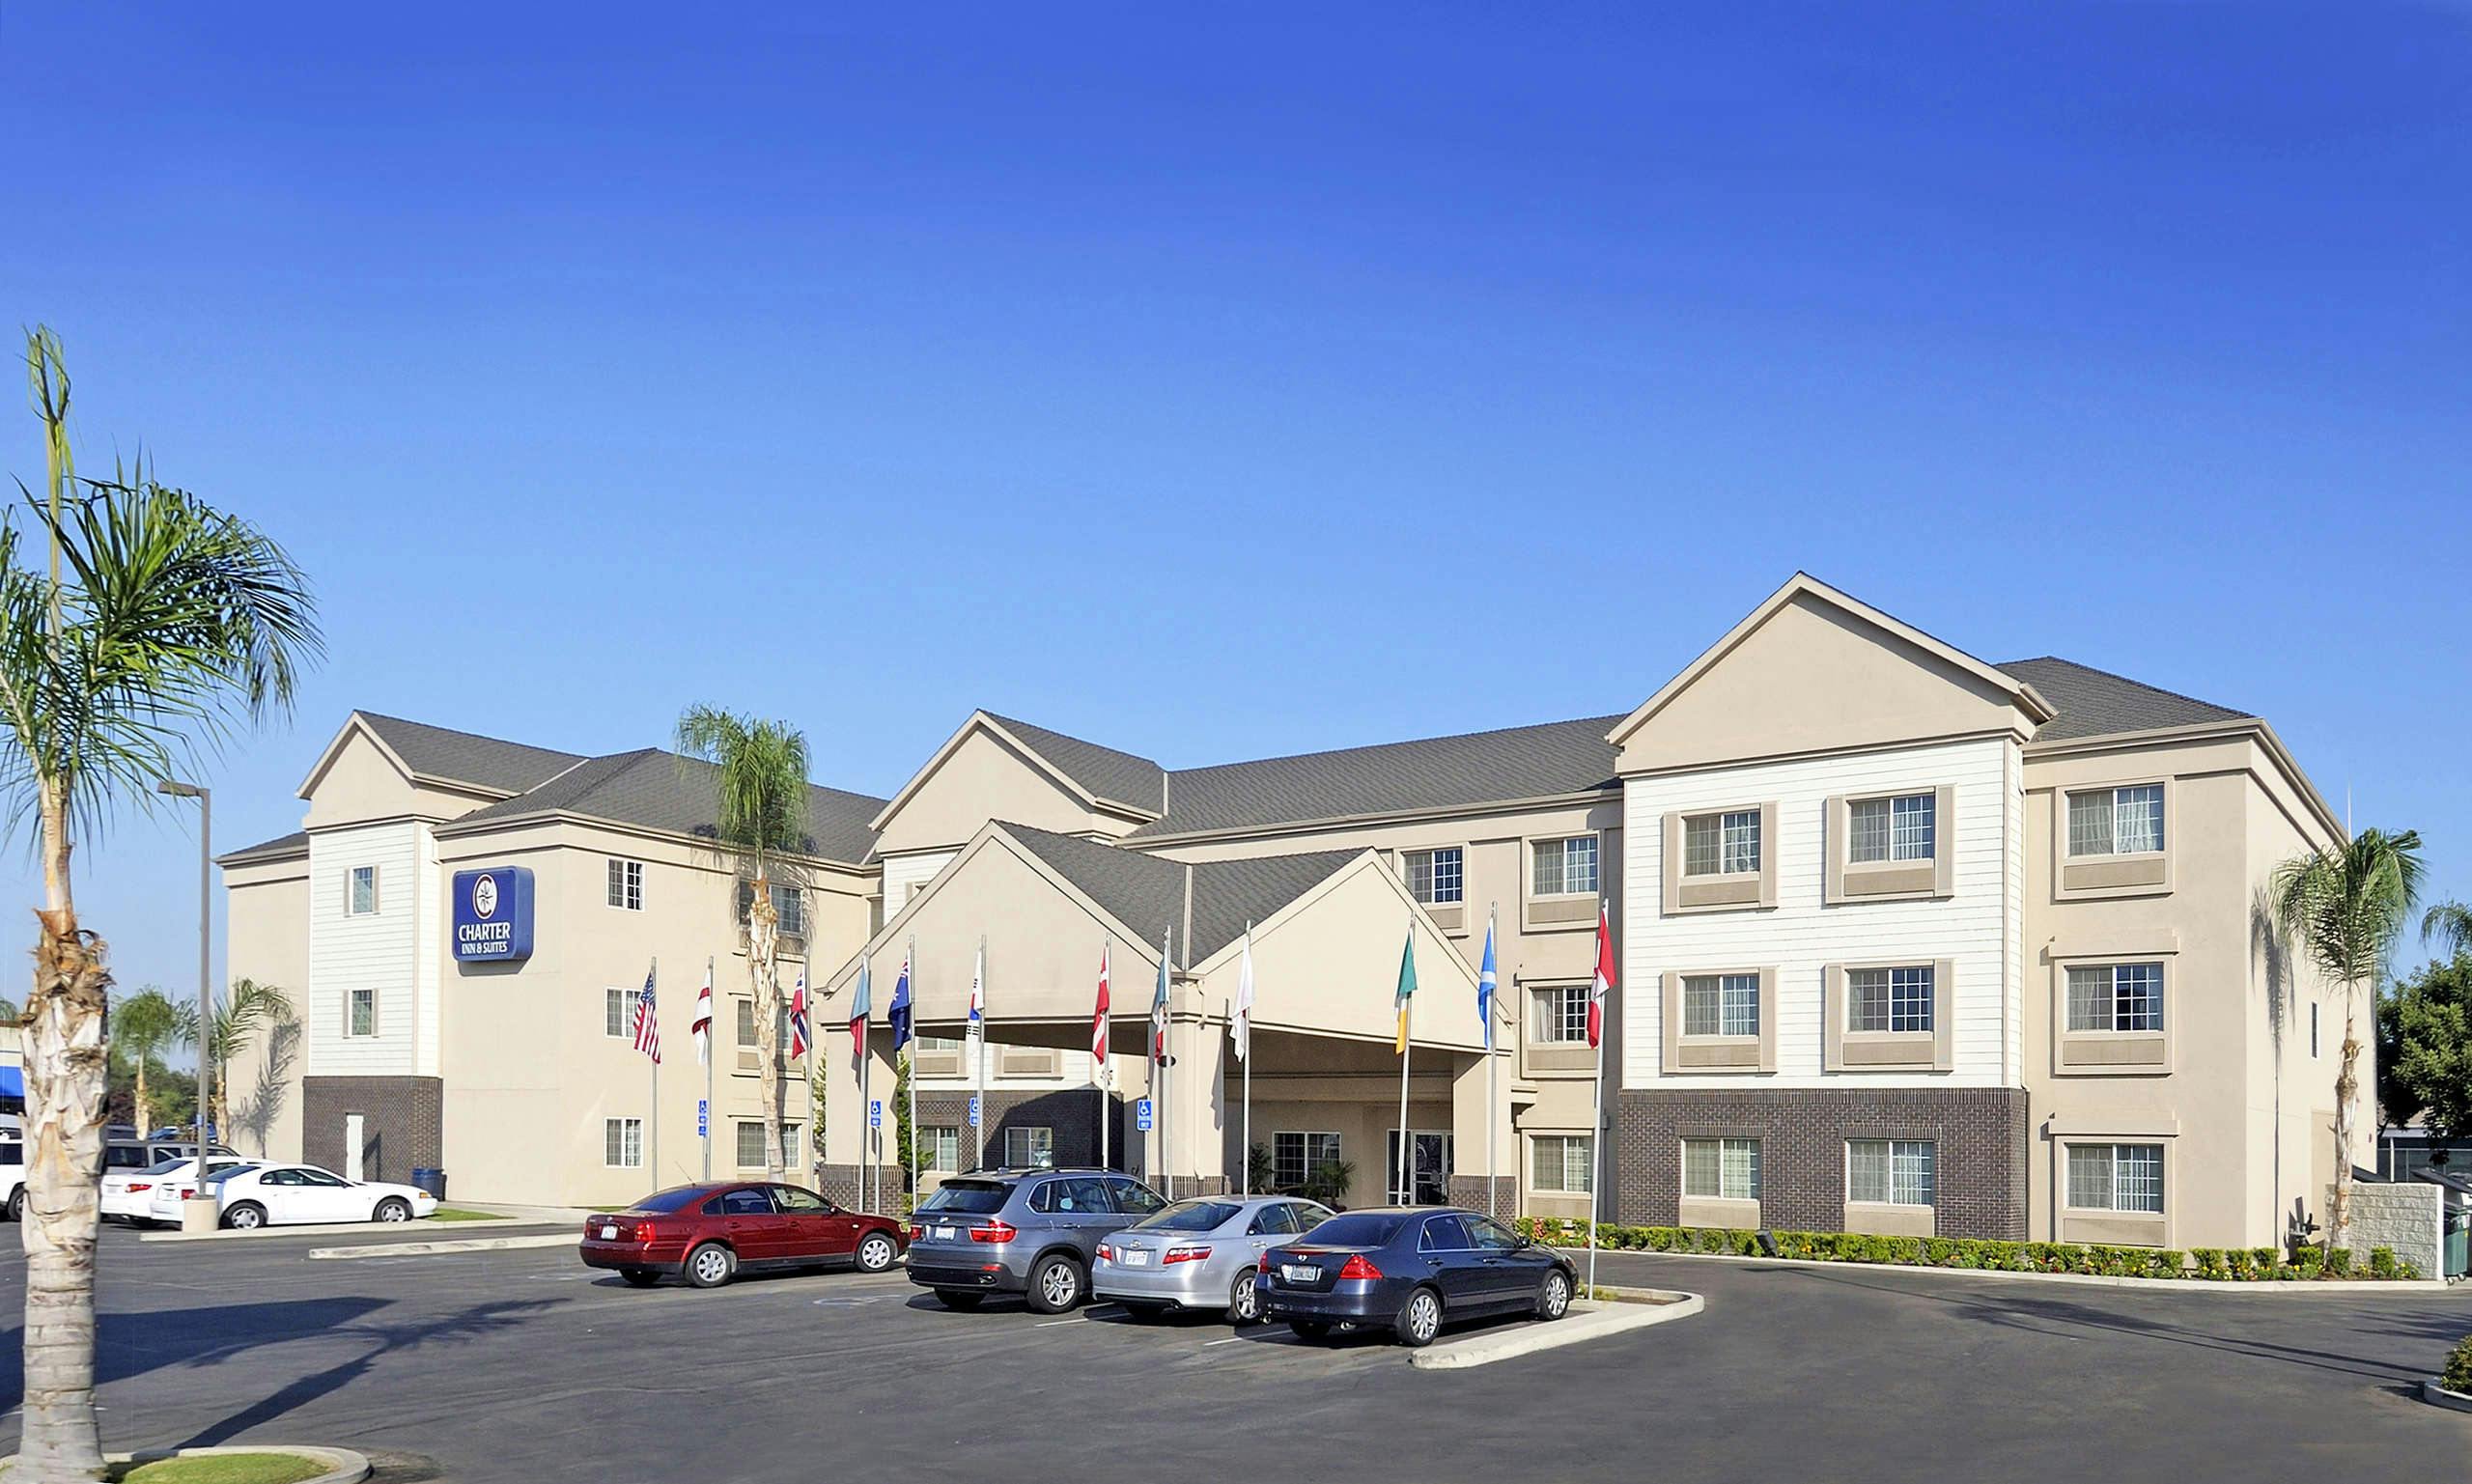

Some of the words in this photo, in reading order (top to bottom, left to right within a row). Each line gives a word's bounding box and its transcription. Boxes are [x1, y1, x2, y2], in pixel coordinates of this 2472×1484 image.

[459, 923, 510, 941] CHARTER
[462, 942, 476, 954] INN
[476, 942, 482, 954] &
[483, 941, 508, 954] SUITES
